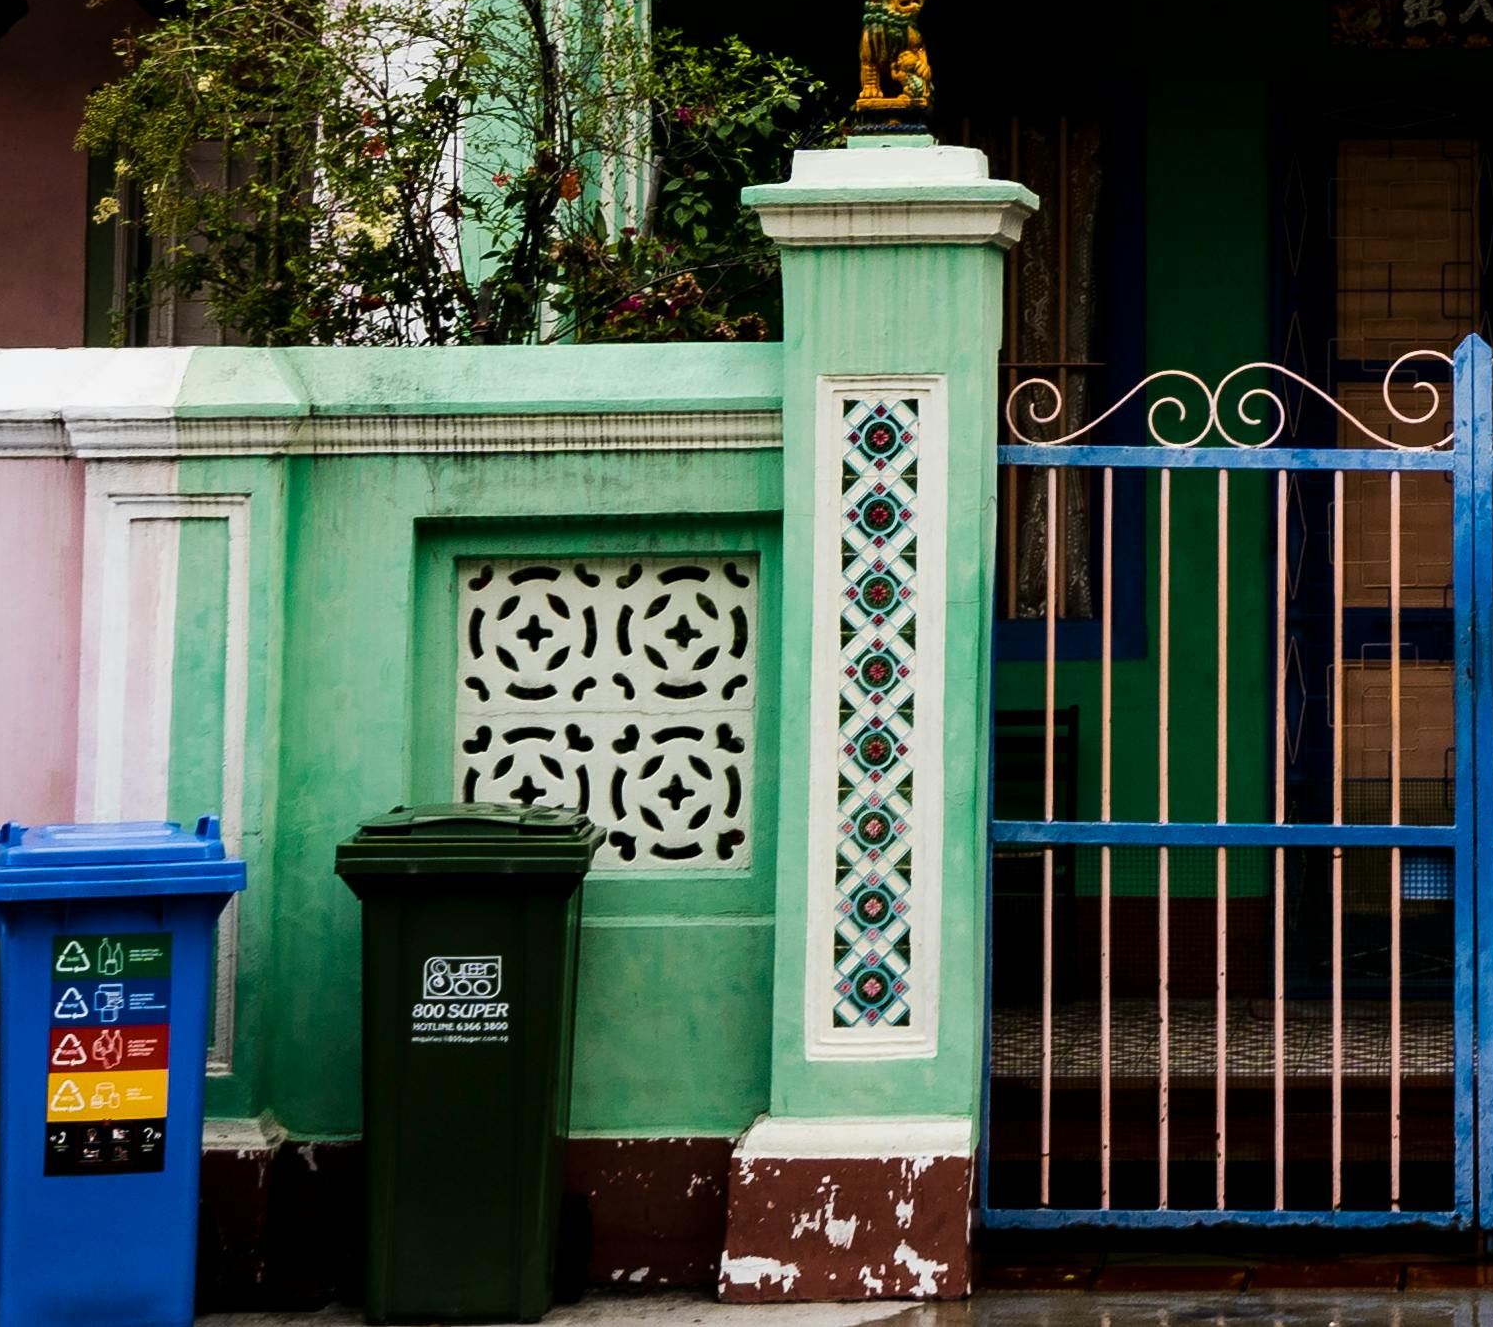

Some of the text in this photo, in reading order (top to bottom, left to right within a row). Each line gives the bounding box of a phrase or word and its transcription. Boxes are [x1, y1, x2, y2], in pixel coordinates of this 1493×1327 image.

[410, 1003, 510, 1019] 800 SUPER
[412, 1022, 455, 1032] HOTLINE
[456, 1021, 482, 1032] 6366
